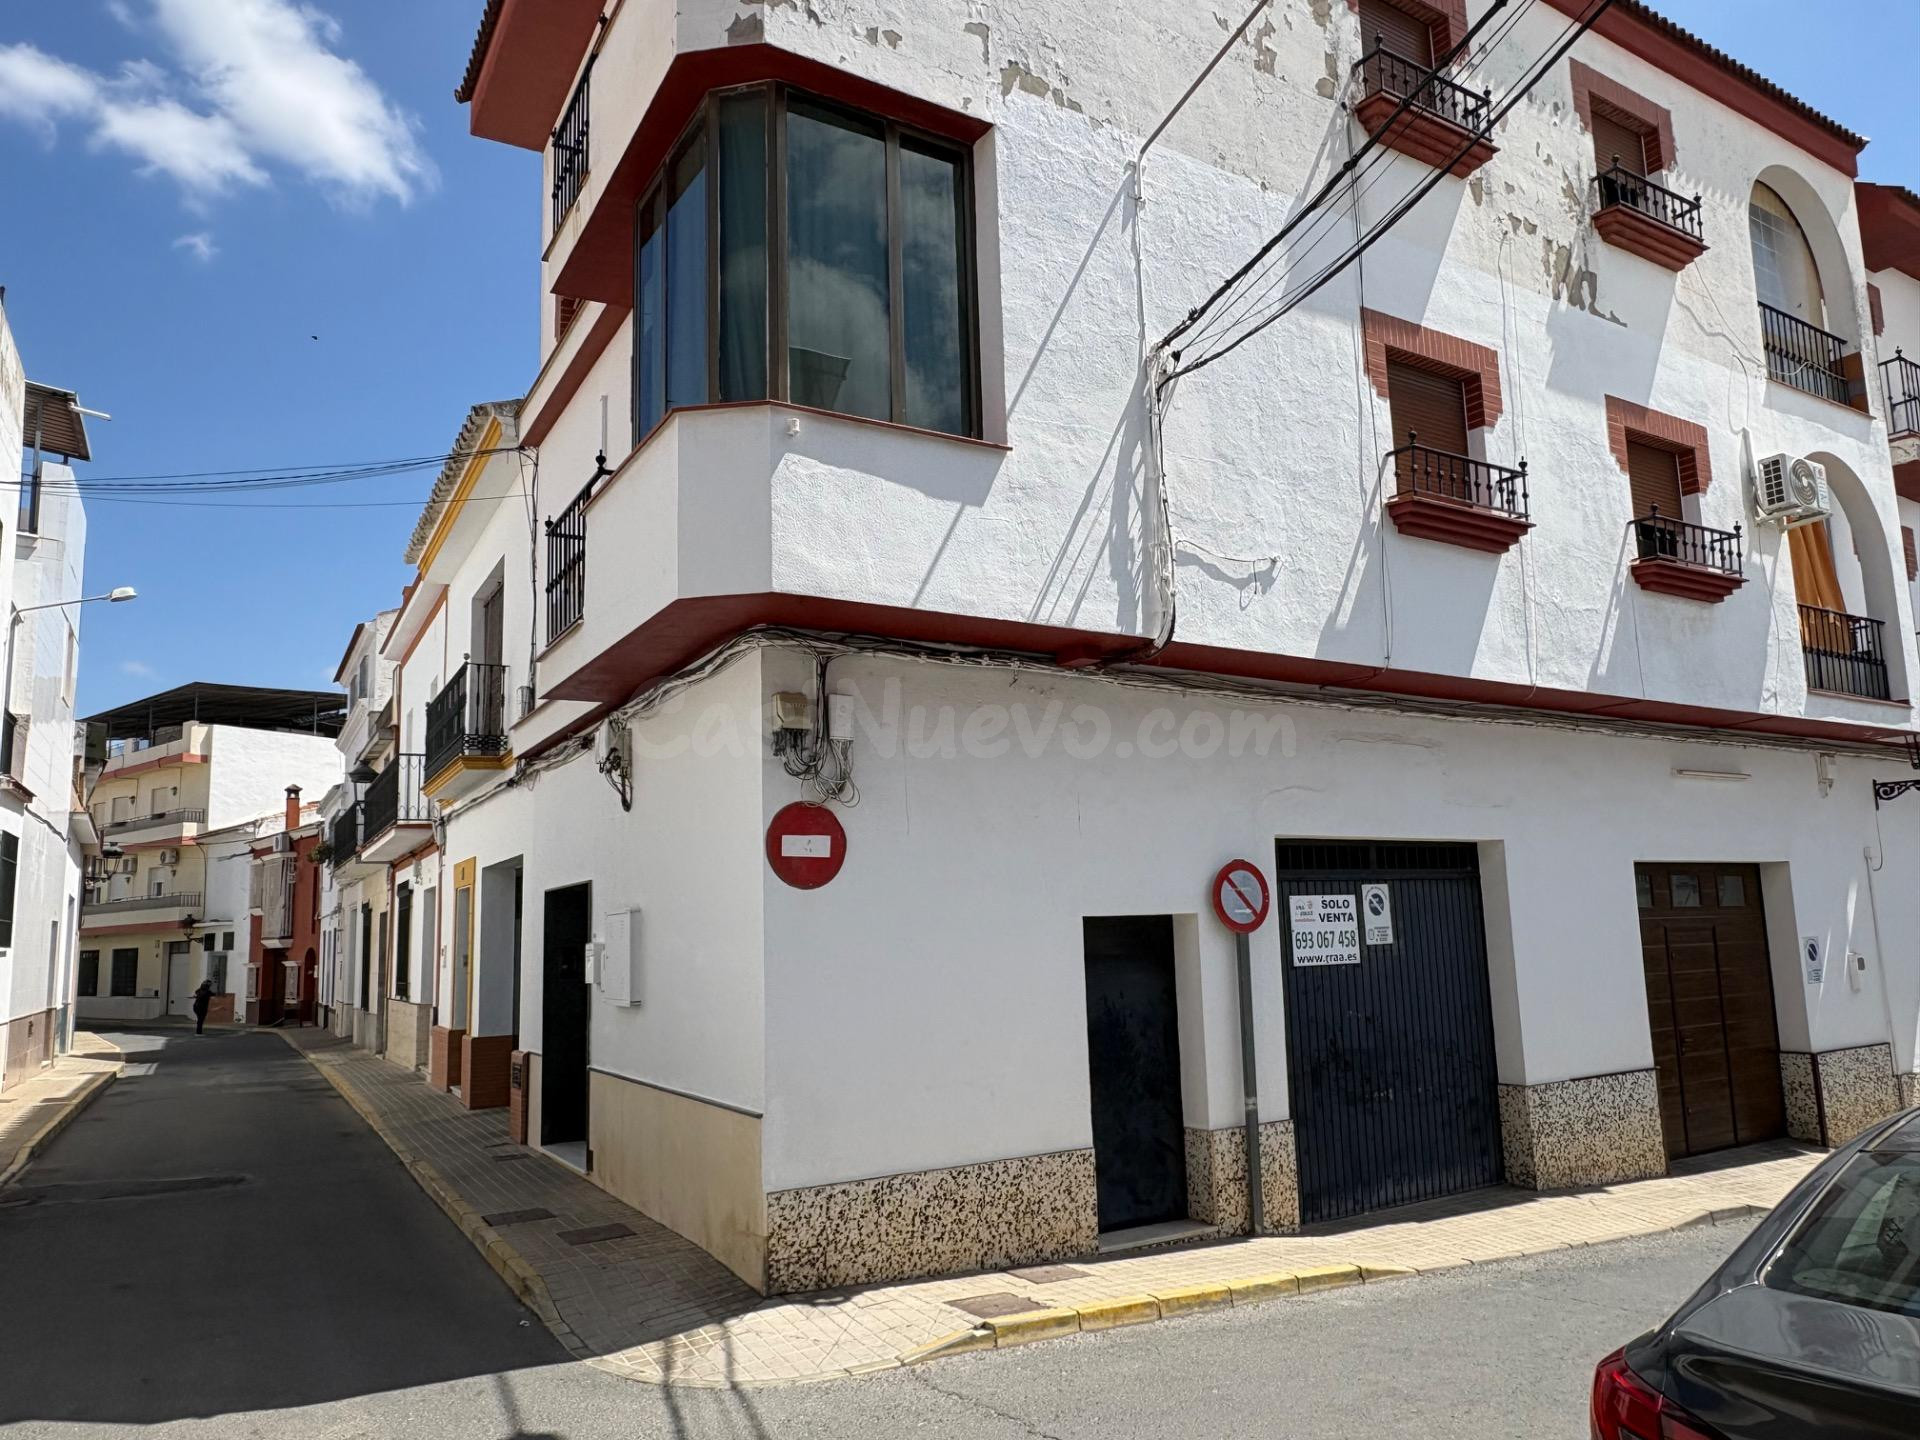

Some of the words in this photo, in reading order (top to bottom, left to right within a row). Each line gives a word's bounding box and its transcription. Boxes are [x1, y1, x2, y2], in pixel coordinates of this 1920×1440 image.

[1321, 899, 1350, 909] SOLO
[1318, 912, 1355, 923] VENTA
[1295, 931, 1314, 950] 693
[1316, 930, 1335, 949] 067
[1338, 929, 1357, 948] 458
